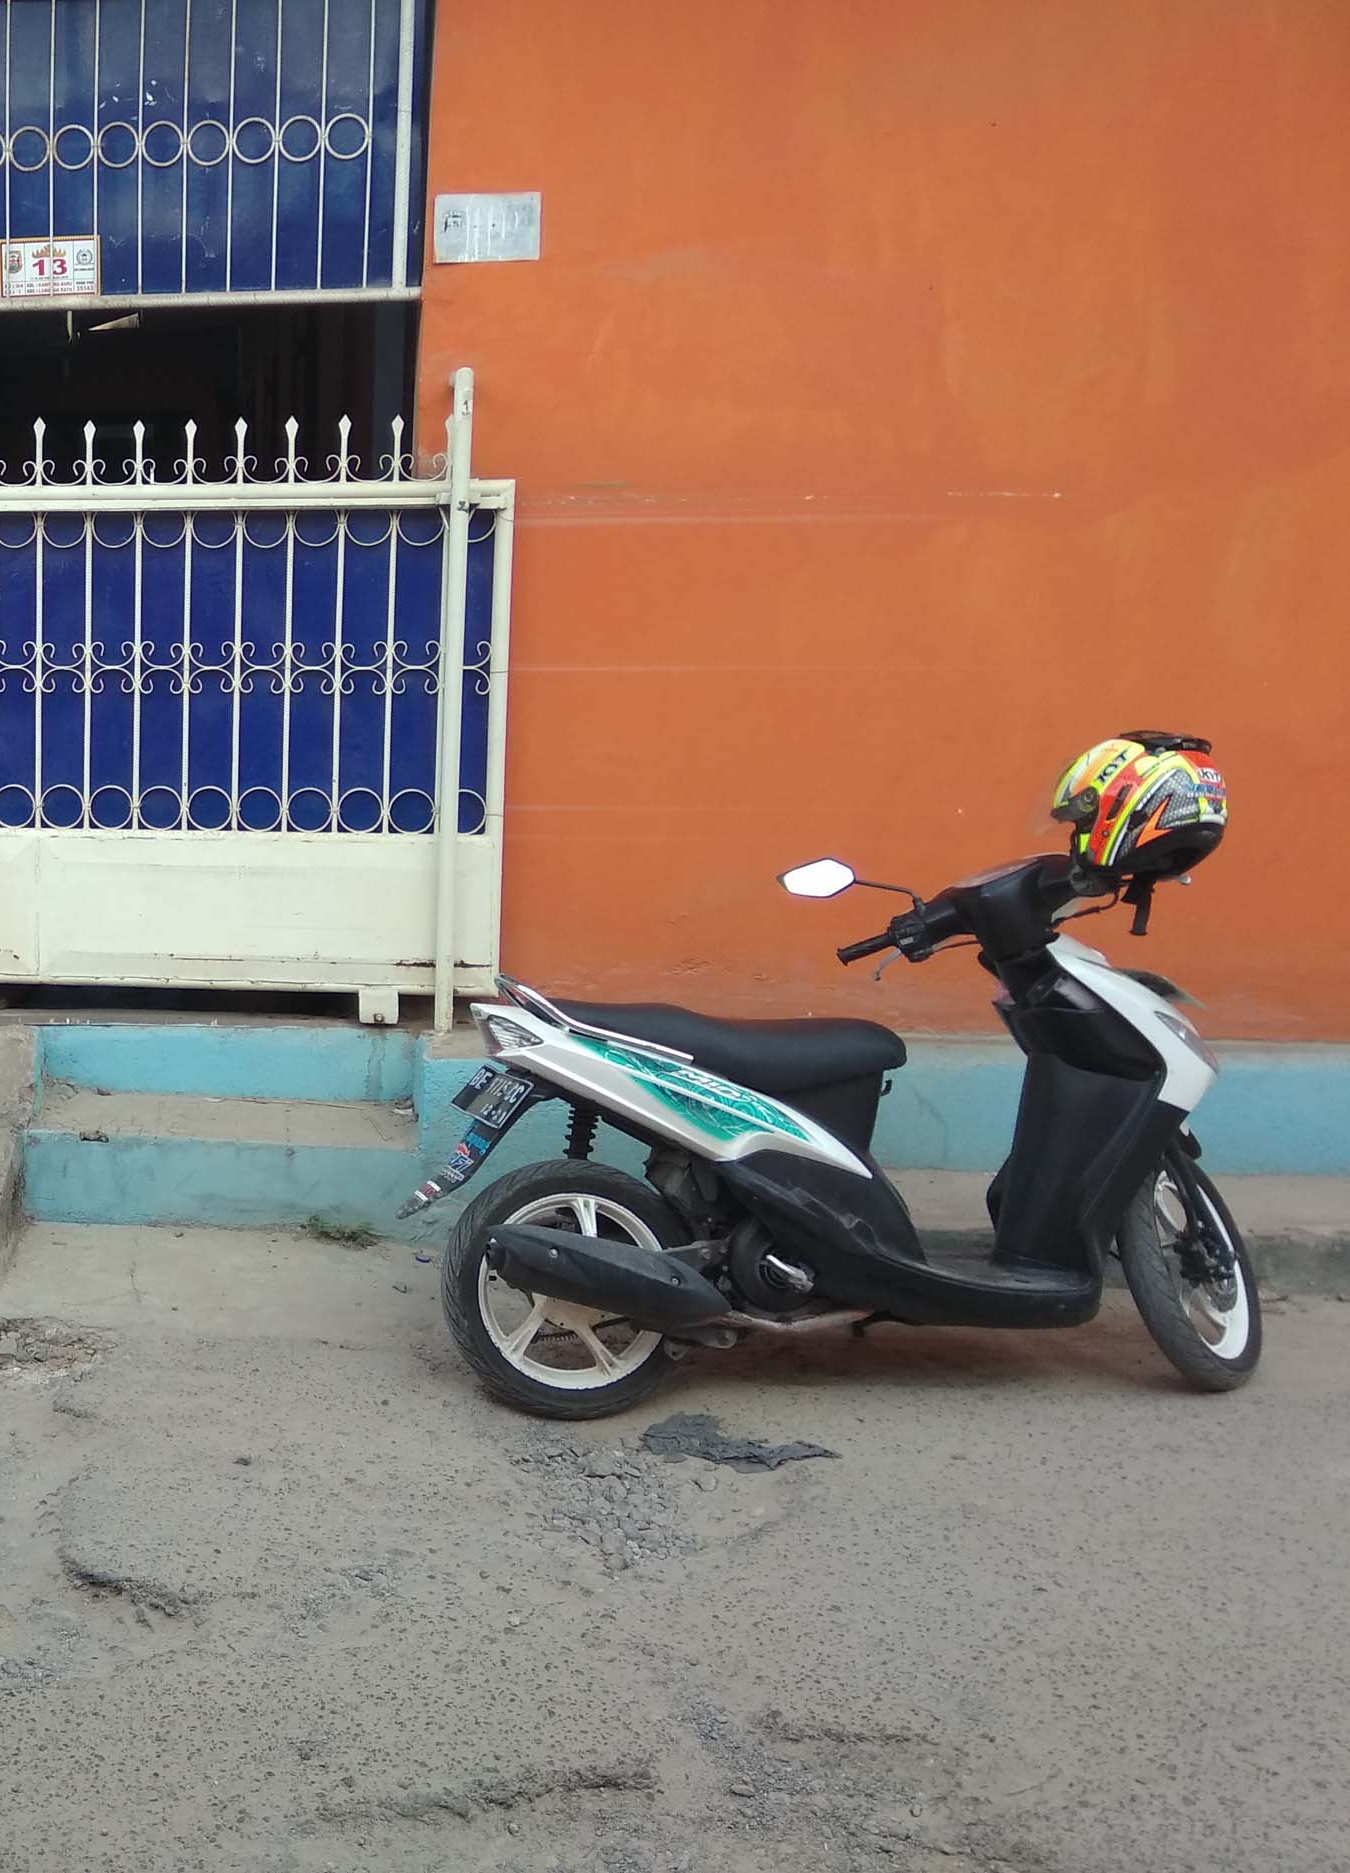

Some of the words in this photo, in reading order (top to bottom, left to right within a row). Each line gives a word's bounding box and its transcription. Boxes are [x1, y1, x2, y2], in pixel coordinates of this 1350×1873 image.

[32, 259, 68, 276] 13
[1097, 748, 1130, 783] KYT
[470, 1068, 493, 1090] BE
